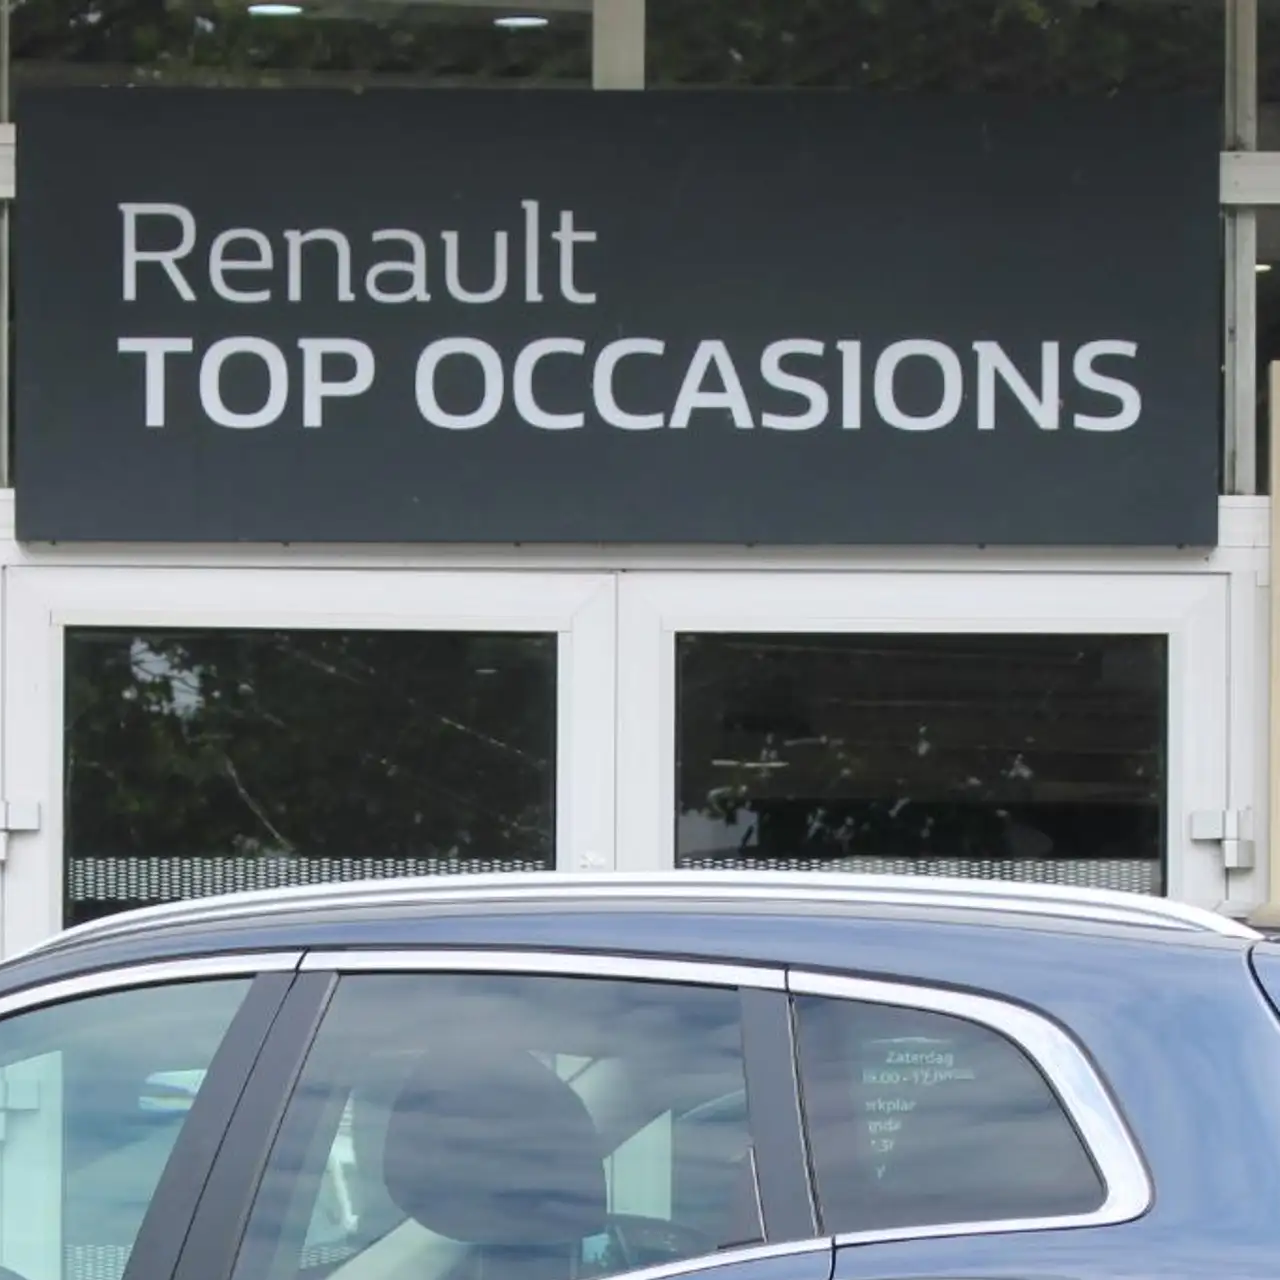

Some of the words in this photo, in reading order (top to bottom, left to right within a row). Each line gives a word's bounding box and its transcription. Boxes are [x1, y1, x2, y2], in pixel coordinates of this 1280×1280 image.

[118, 200, 597, 304] Renault
[118, 337, 375, 429] TOP
[414, 336, 1143, 432] OCCASIONS
